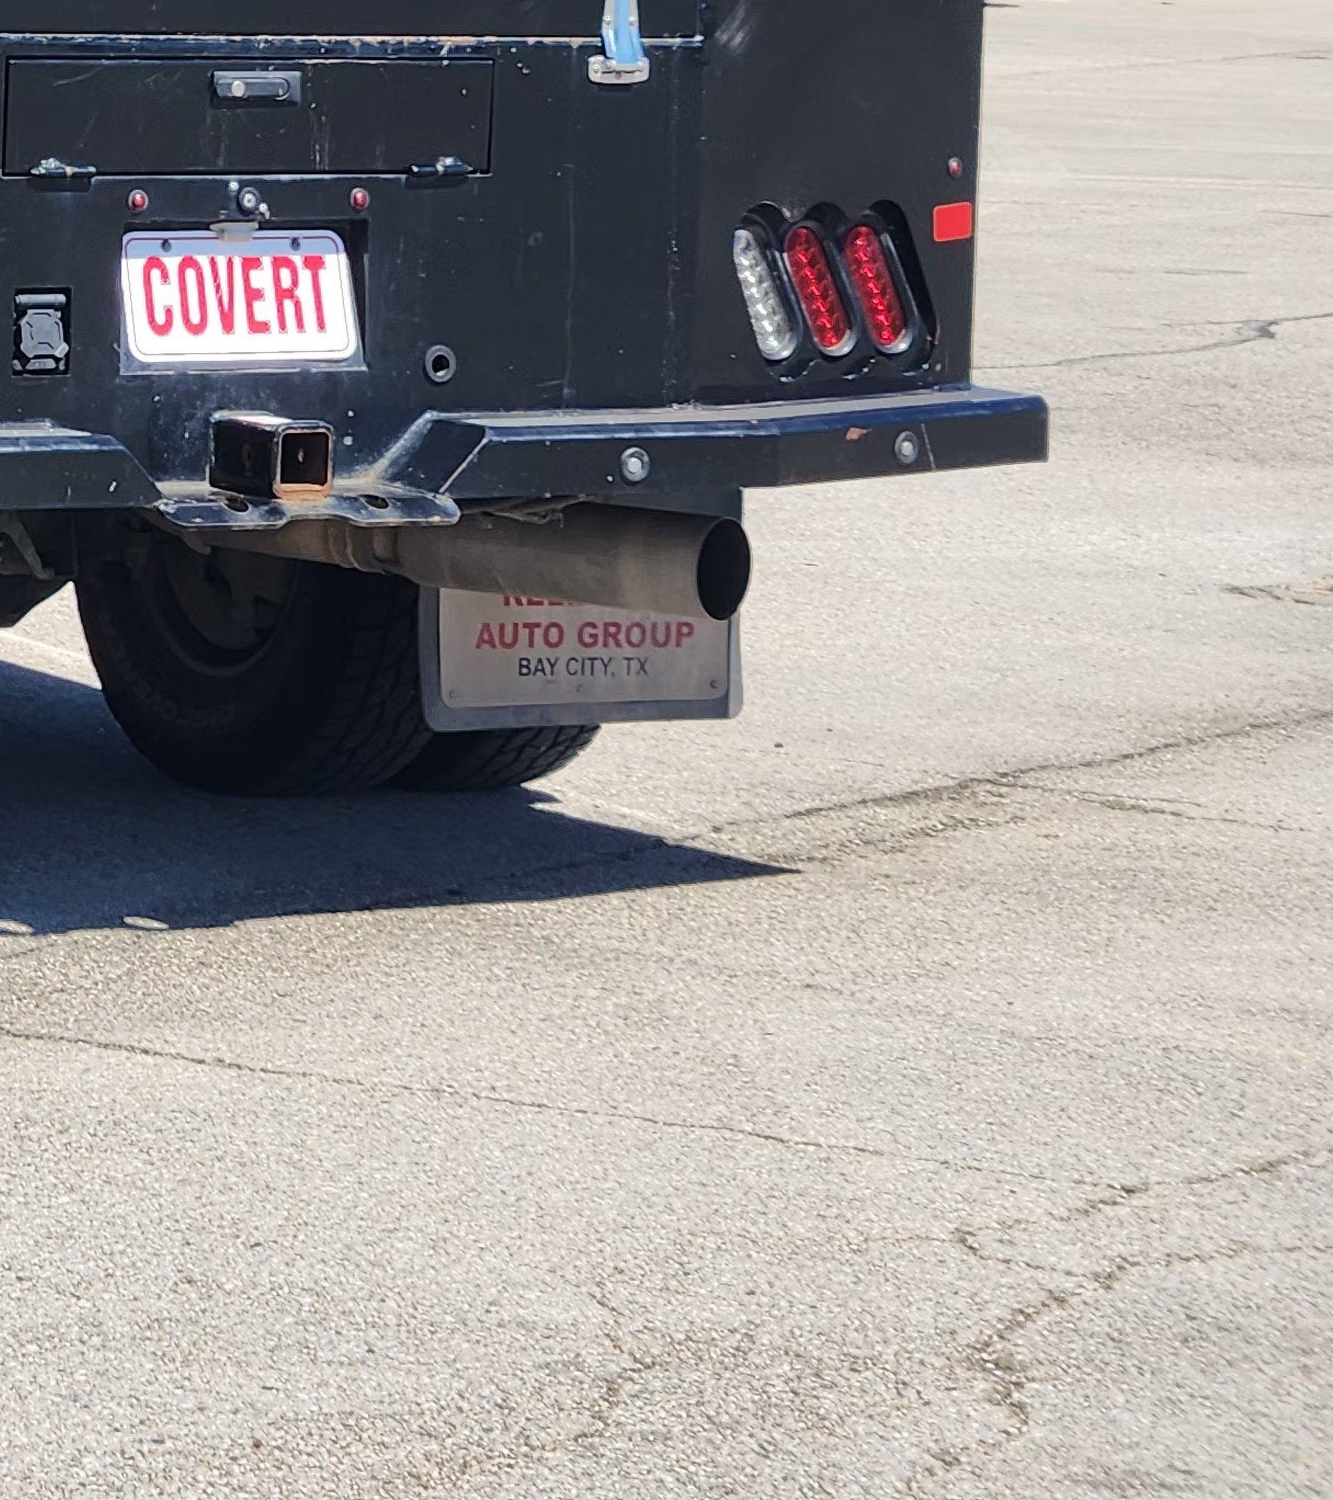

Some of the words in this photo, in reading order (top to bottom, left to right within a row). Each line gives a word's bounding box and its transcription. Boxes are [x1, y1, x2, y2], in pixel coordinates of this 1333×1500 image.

[142, 255, 327, 337] COVERT
[475, 622, 565, 650] AUTO
[577, 621, 696, 649] GROUP
[518, 657, 560, 677] BAY
[565, 657, 617, 677] CITY,
[623, 657, 649, 676] TX
